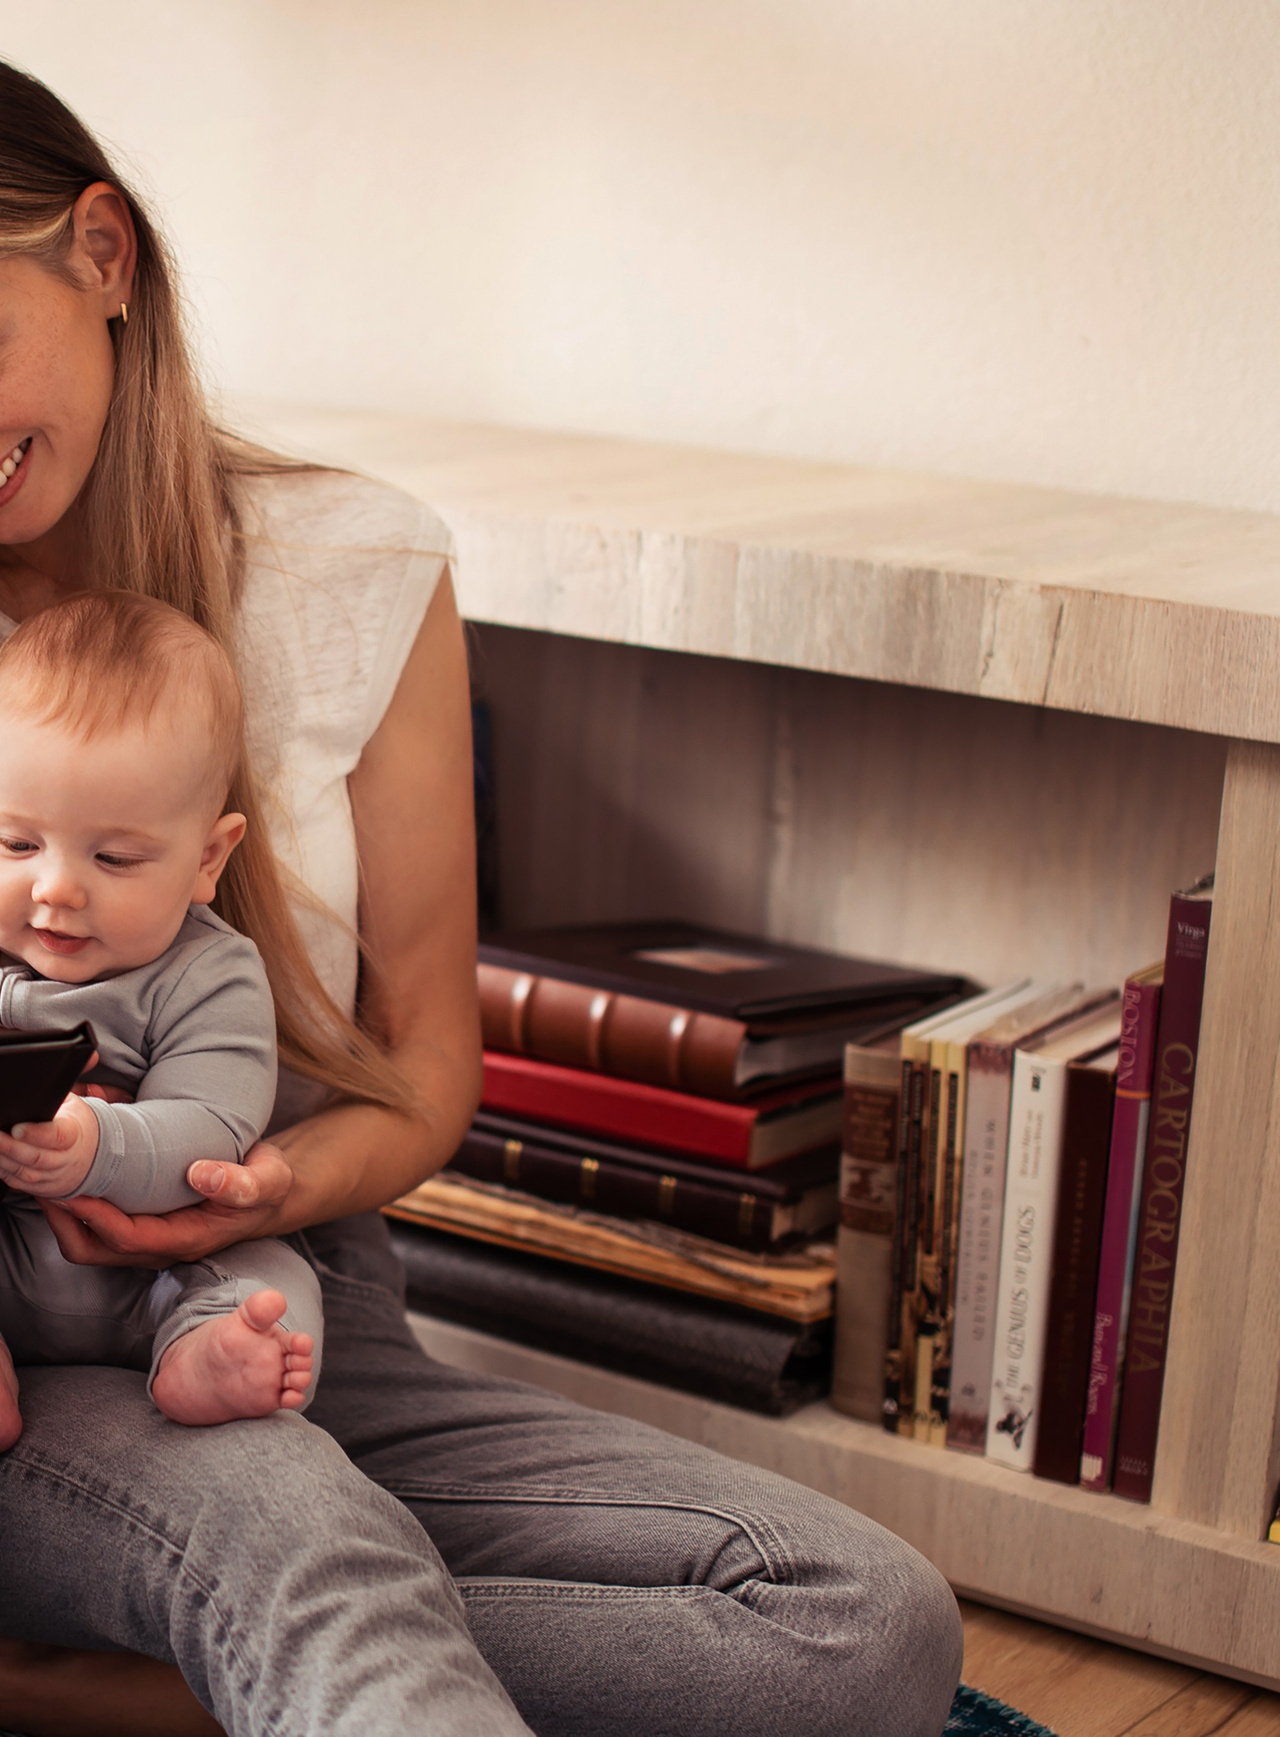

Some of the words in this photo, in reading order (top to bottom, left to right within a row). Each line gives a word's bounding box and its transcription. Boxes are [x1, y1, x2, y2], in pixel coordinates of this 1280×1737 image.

[1117, 988, 1140, 1084] BOSTON
[1013, 1204, 1036, 1263] DOGS
[1130, 1041, 1194, 1374] CARTOGRAPHIA
[1006, 1286, 1029, 1359] GENIUS
